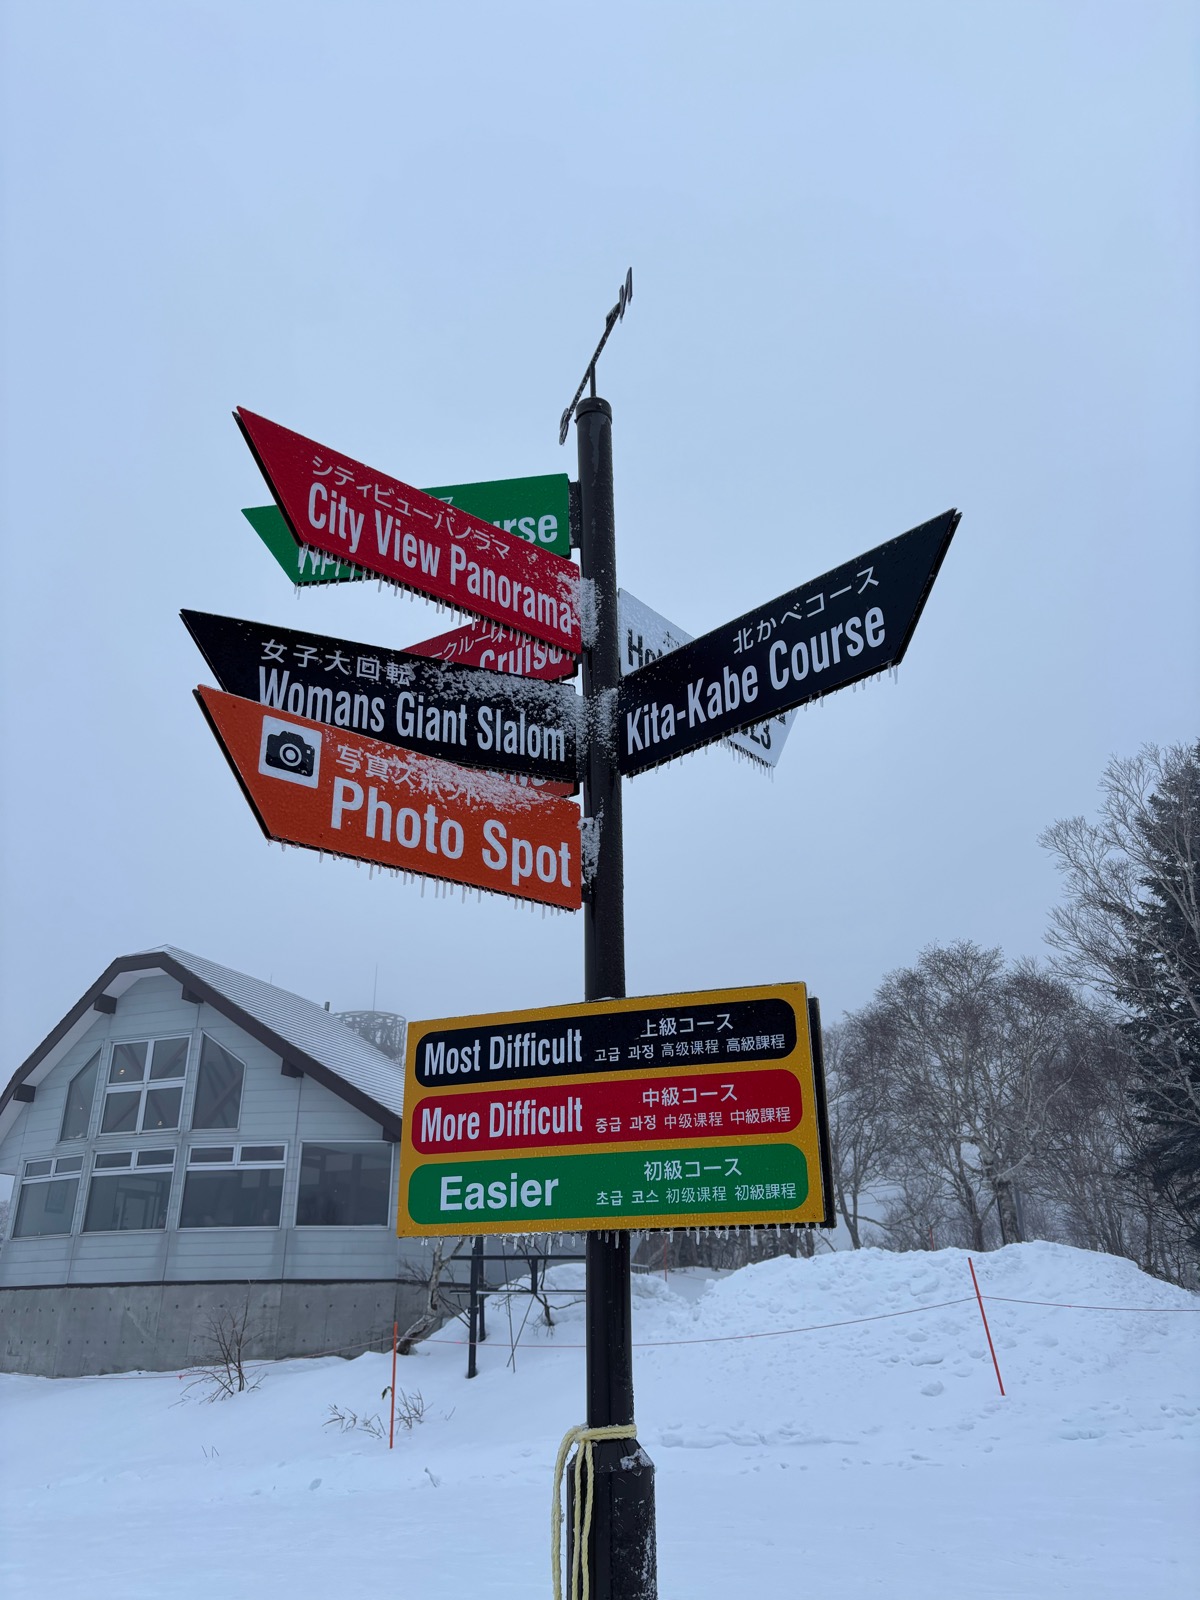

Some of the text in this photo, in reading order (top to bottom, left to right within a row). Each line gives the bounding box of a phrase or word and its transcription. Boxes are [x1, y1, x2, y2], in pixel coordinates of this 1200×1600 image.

[311, 455, 510, 560] シティビューパノラマ
[308, 481, 573, 635] City View Panorama
[732, 565, 880, 655] 北かべコース
[260, 638, 412, 687] 女子大回転
[626, 664, 759, 756] Kita-Kabe
[768, 606, 886, 691] Course
[258, 665, 566, 762] Womans Giant Slalom
[330, 776, 572, 888] Photo Spot
[594, 1033, 786, 1063] 고급 과정 高级课程 高級課程
[640, 1013, 734, 1038] 上級コース
[424, 1028, 583, 1076] Most Difficult
[420, 1096, 583, 1143] More Difficult
[595, 1106, 791, 1133] 중급 과정 中级课程 中級課程
[642, 1084, 738, 1108] 中級コース
[440, 1172, 559, 1211] Easier
[643, 1158, 743, 1182] 初級コース
[596, 1182, 797, 1206] 초급 코스 初级课程 初級課程
